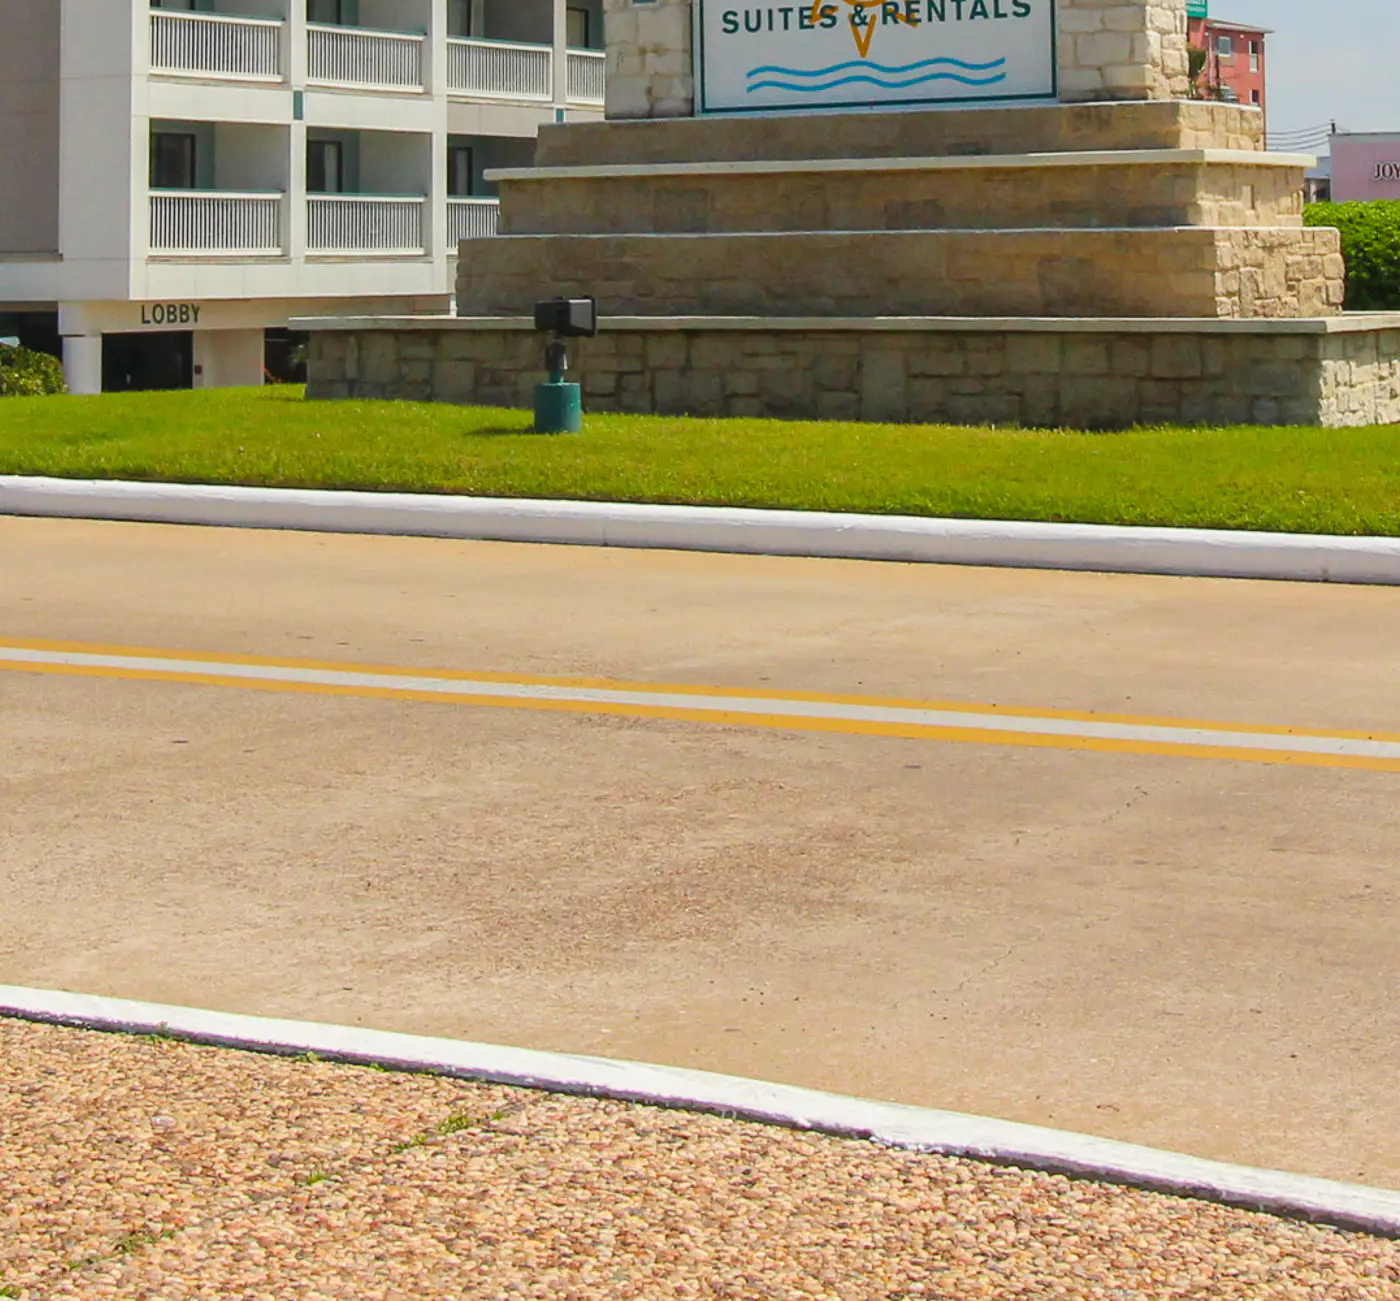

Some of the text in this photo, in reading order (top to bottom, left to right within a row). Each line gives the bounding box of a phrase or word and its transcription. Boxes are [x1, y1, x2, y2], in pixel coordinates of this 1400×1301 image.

[722, 4, 838, 34] SUITES
[851, 4, 869, 26] &
[141, 303, 201, 324] LOBBY
